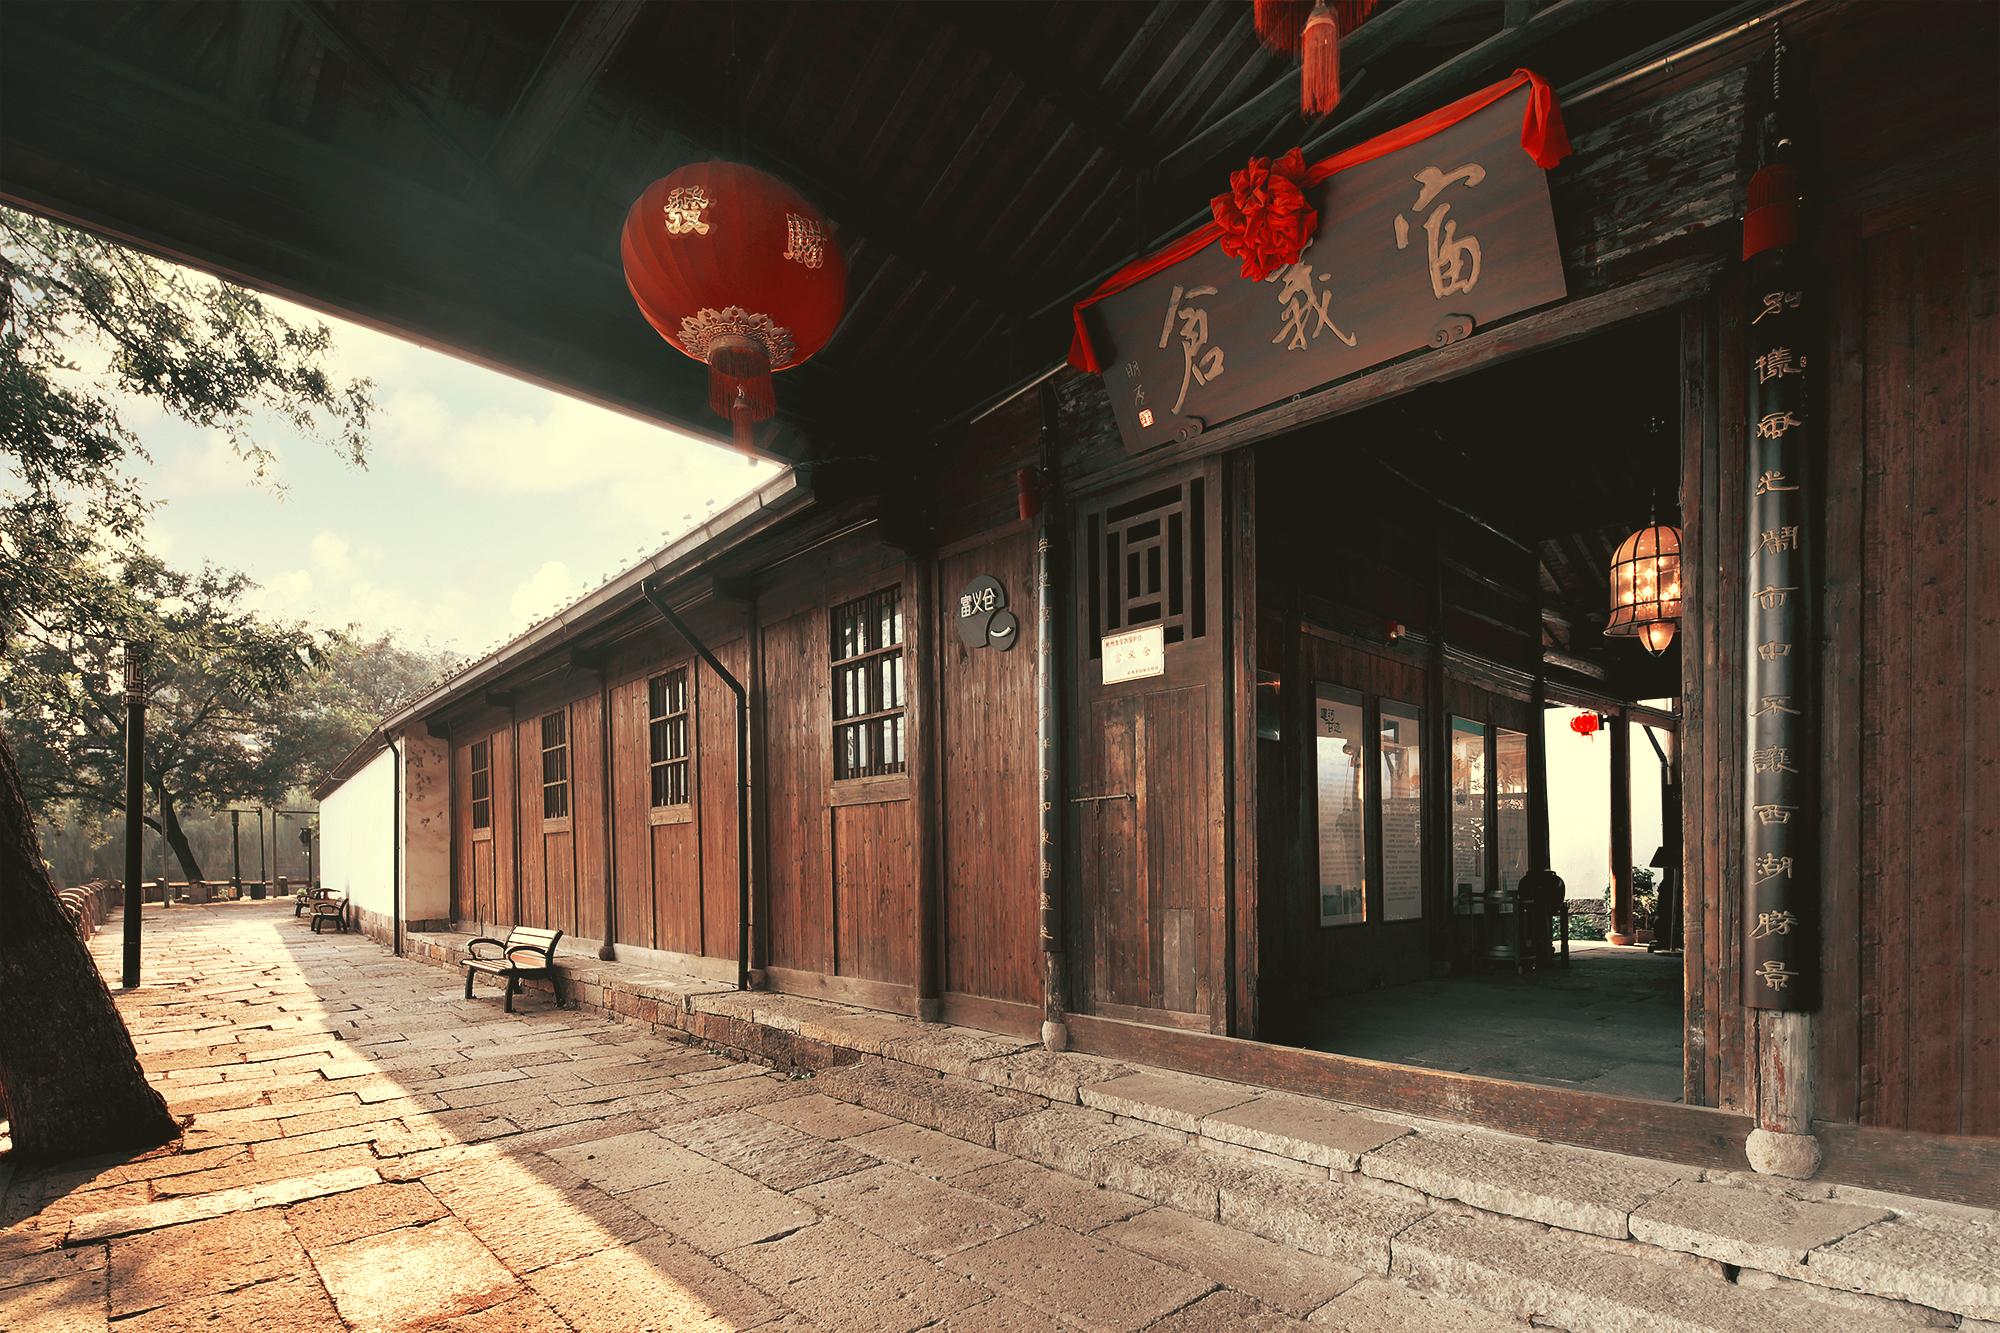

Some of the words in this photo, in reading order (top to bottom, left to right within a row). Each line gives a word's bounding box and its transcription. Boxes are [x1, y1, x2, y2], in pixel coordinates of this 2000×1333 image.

[664, 185, 710, 235] 發
[960, 587, 997, 618] 富义仓
